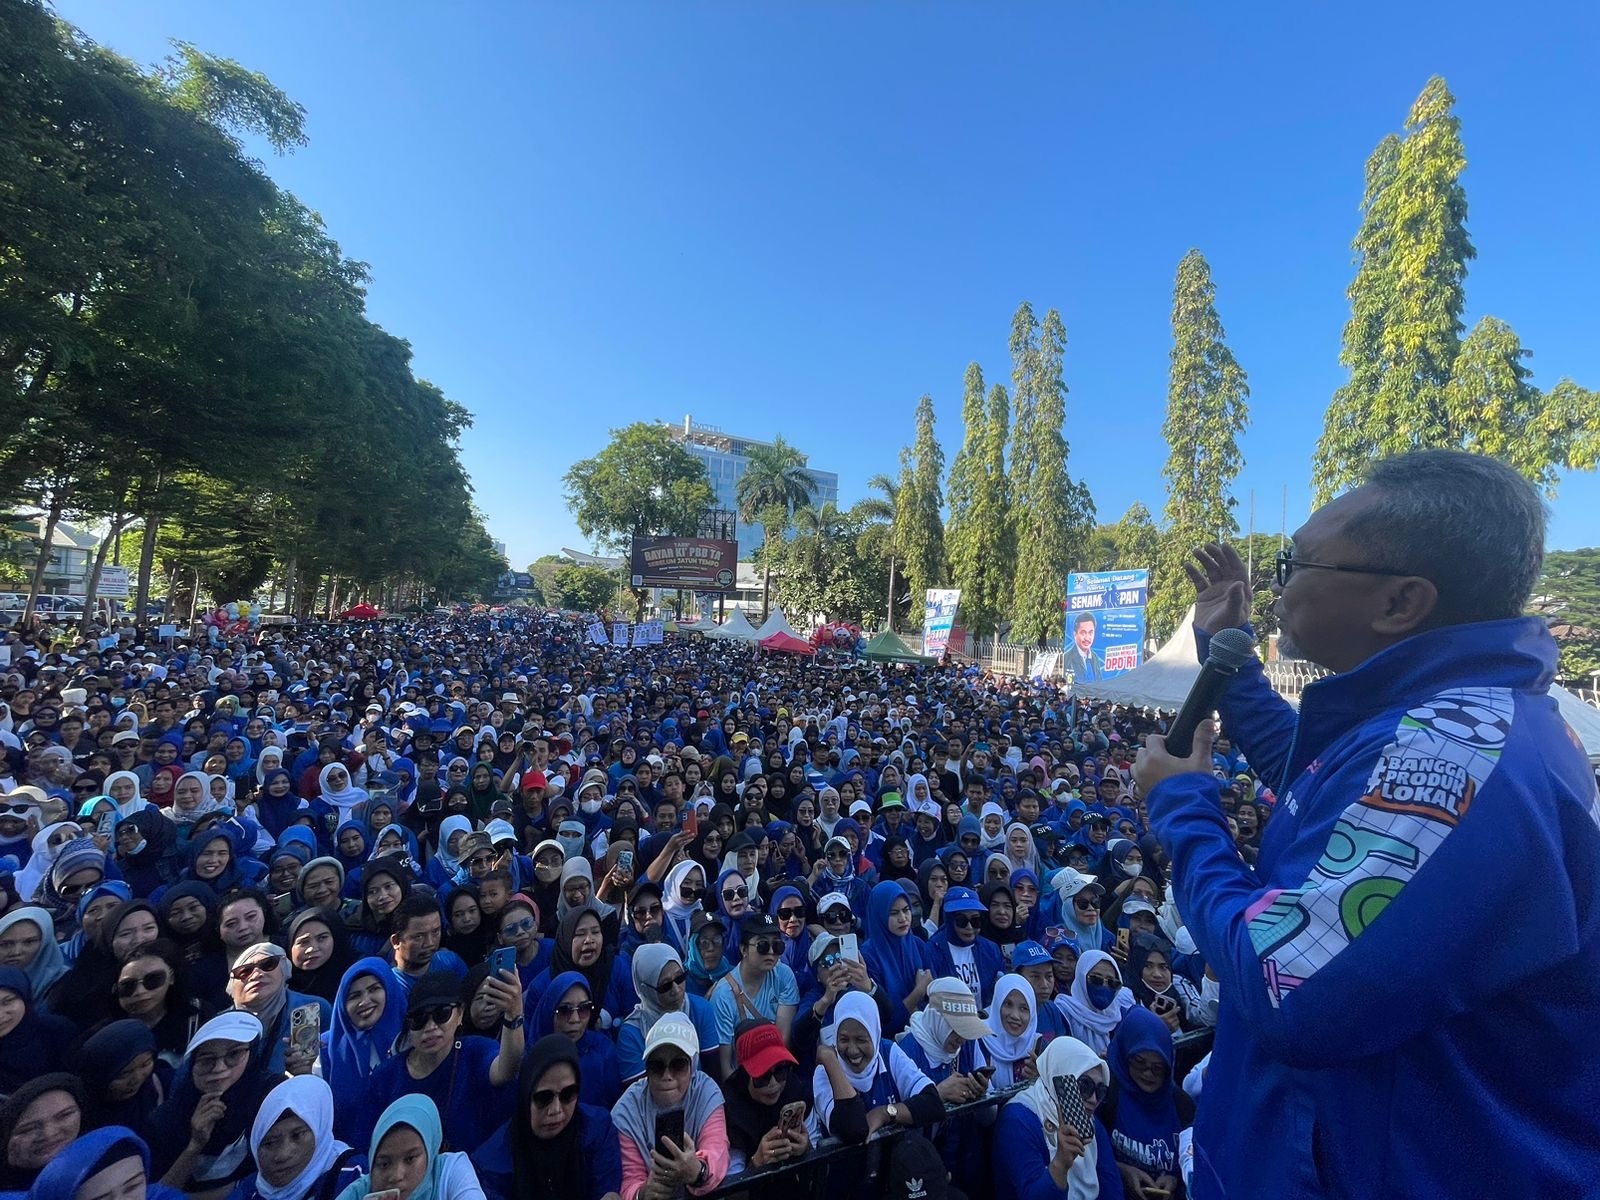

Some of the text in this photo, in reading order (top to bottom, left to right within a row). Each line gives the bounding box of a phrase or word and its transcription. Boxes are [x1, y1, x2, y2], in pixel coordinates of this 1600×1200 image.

[644, 548, 674, 561] BAYAR
[689, 547, 708, 558] PBB
[699, 559, 719, 567] TEMPO
[1071, 590, 1139, 609] SENAM PAN
[1385, 770, 1466, 798] PRODUK
[1381, 783, 1459, 817] LOKAL
